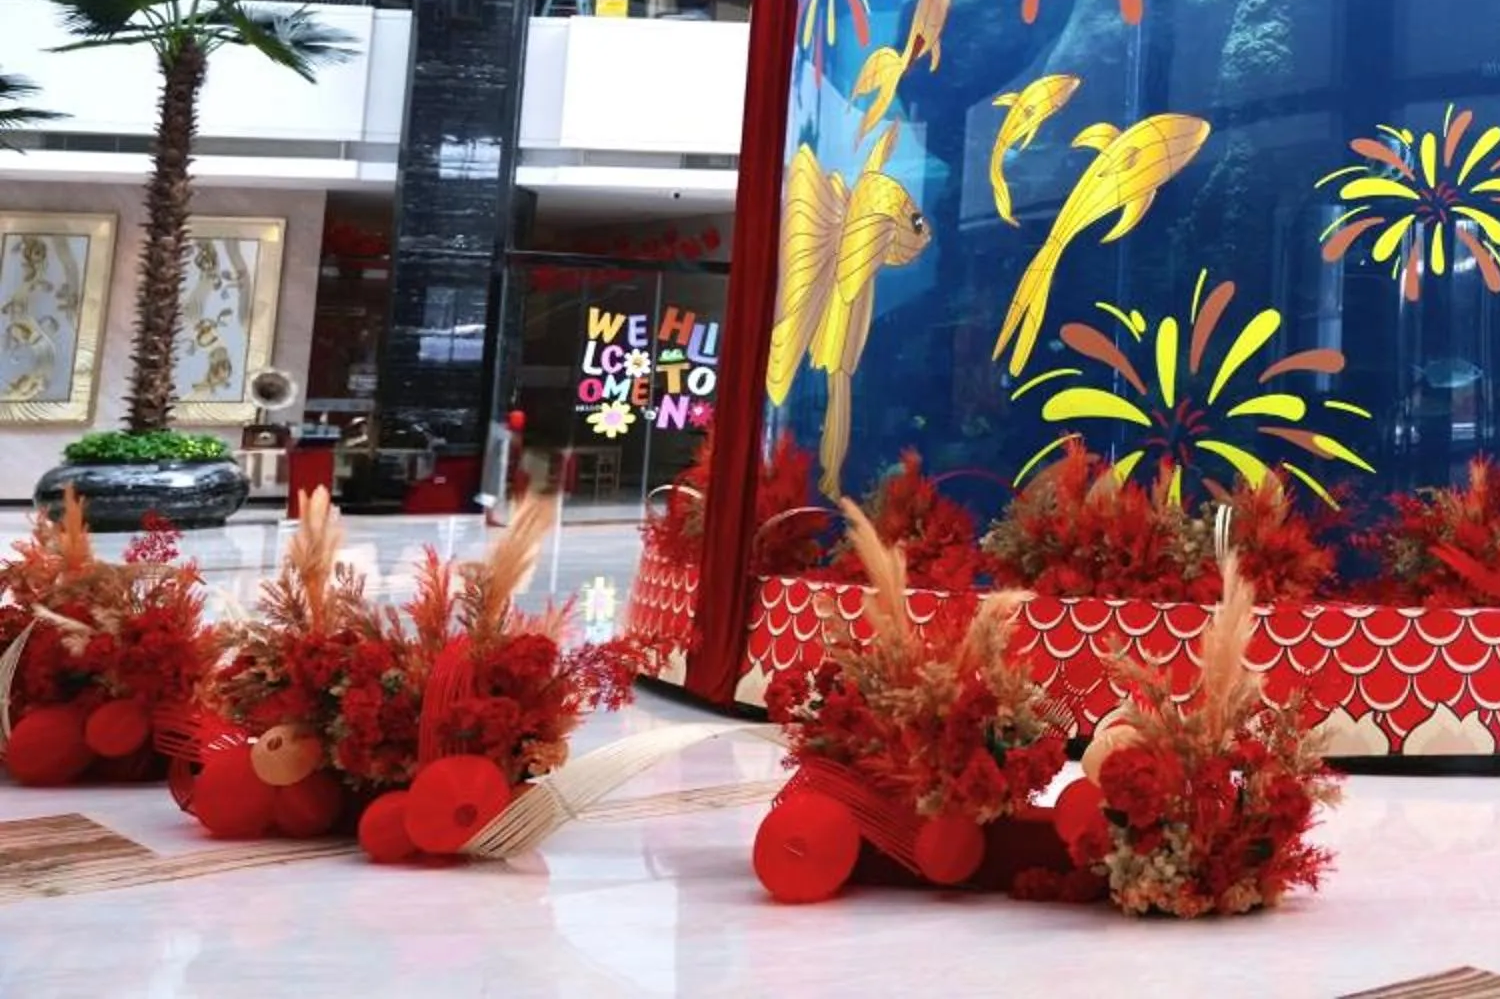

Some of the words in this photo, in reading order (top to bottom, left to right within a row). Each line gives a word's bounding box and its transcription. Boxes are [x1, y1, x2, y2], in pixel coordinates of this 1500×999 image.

[588, 307, 648, 347] WE
[656, 363, 716, 396] TO
[656, 394, 690, 429] N
